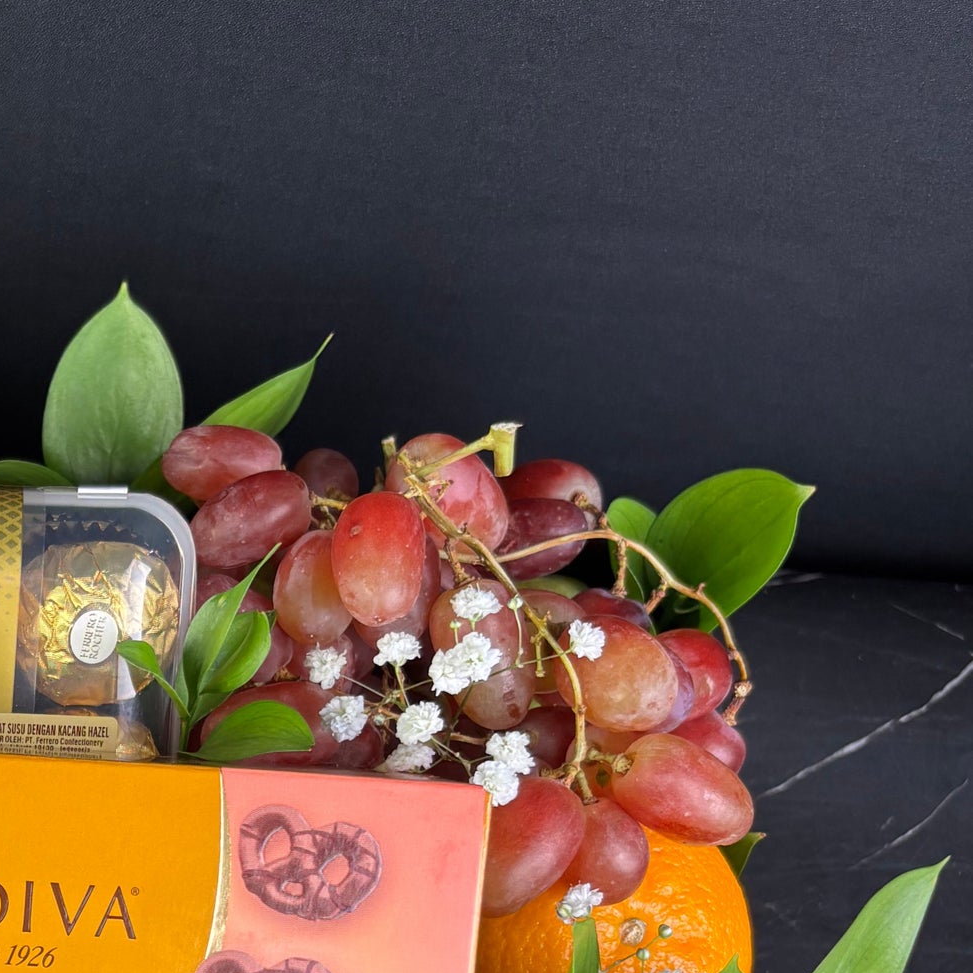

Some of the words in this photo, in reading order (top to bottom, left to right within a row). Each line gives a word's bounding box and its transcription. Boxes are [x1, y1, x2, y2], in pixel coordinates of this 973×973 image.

[80, 613, 97, 658] FERRERO
[6, 723, 26, 735] SUSU
[27, 724, 56, 736] DENGAN
[58, 725, 87, 738] KACANG
[88, 726, 110, 738] HAZEL
[5, 735, 25, 744] OLEH:
[35, 737, 59, 745] Ferrero
[59, 738, 104, 748] Confectionery
[4, 944, 58, 968] 1926
